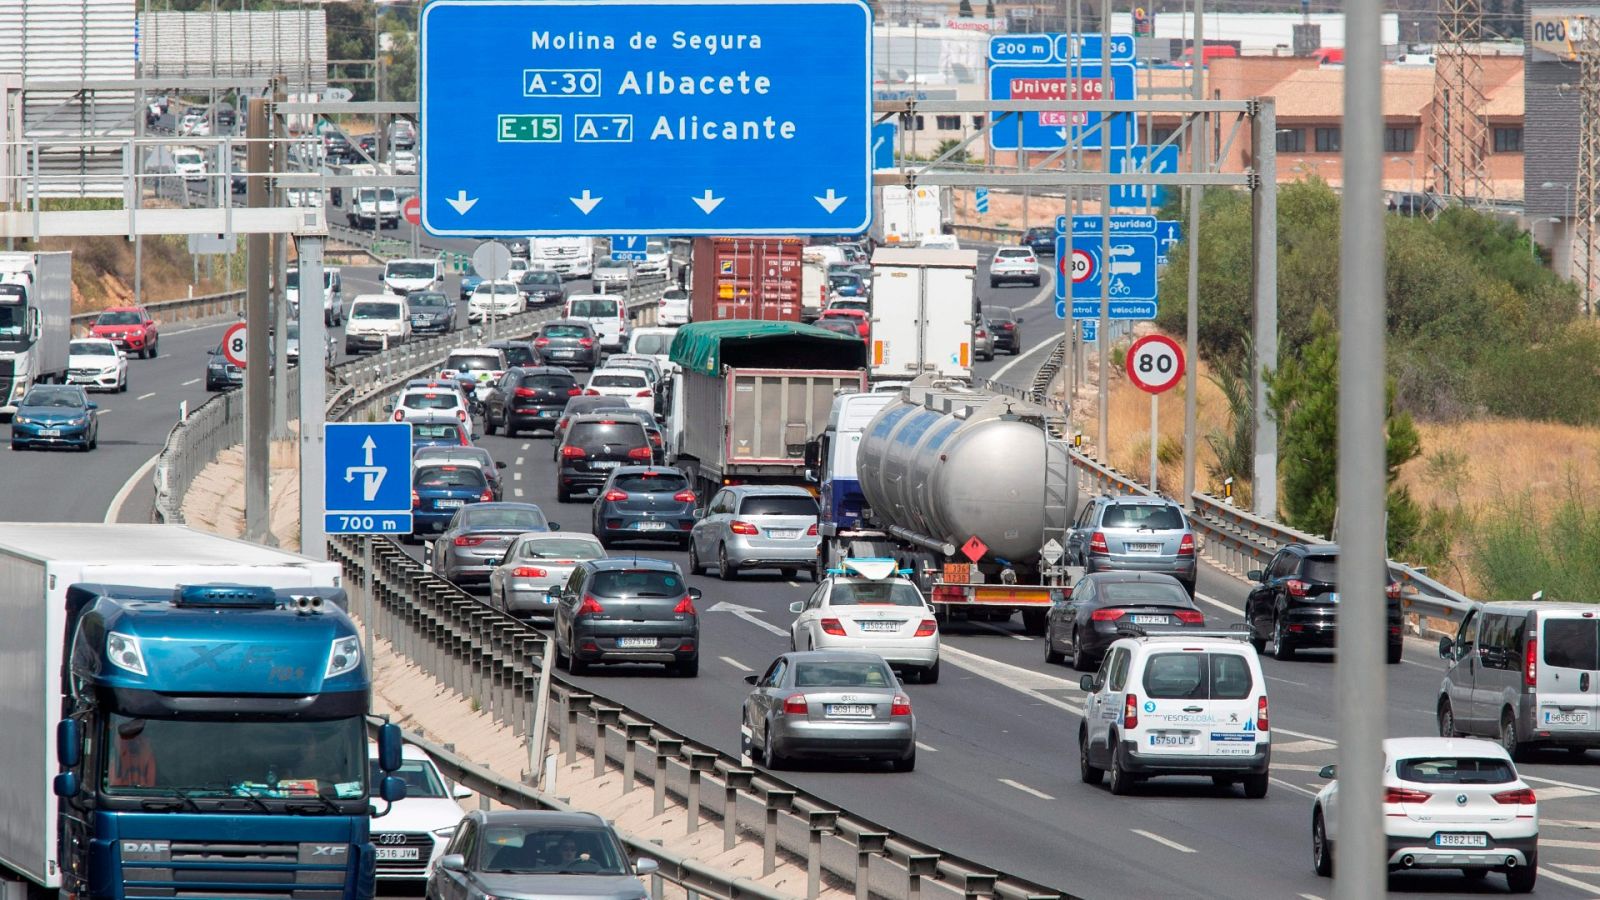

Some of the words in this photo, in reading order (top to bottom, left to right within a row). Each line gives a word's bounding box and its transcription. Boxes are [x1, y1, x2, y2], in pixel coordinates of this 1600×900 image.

[531, 31, 615, 50] Molina
[629, 31, 657, 50] de
[672, 31, 761, 56] Segura
[997, 43, 1026, 54] 200
[1032, 44, 1044, 54] m
[528, 73, 597, 94] A-30
[617, 70, 771, 95] Albacete
[1011, 80, 1113, 94] Universda
[1041, 112, 1086, 124] (Ese)
[501, 118, 558, 139] E-15
[579, 118, 629, 139] A-7
[650, 115, 796, 140] Alicante
[1060, 219, 1079, 229] Pr
[1083, 220, 1096, 229] su
[1108, 219, 1152, 230] eguridad
[1063, 306, 1092, 315] ntrol
[1111, 306, 1151, 315] velocidad
[232, 337, 247, 353] 8
[1139, 353, 1172, 374] 80
[339, 516, 374, 530] 700
[382, 520, 397, 530] m
[865, 622, 884, 630] 3502
[833, 705, 852, 714] 9091
[1145, 702, 1154, 713] 3
[1156, 736, 1177, 745] 5750
[1178, 736, 1195, 745] LFJ
[1442, 835, 1465, 845] 3882
[1467, 835, 1484, 845] LHL
[123, 843, 170, 853] DAF
[311, 846, 347, 856] XF
[399, 849, 418, 858] JVM
